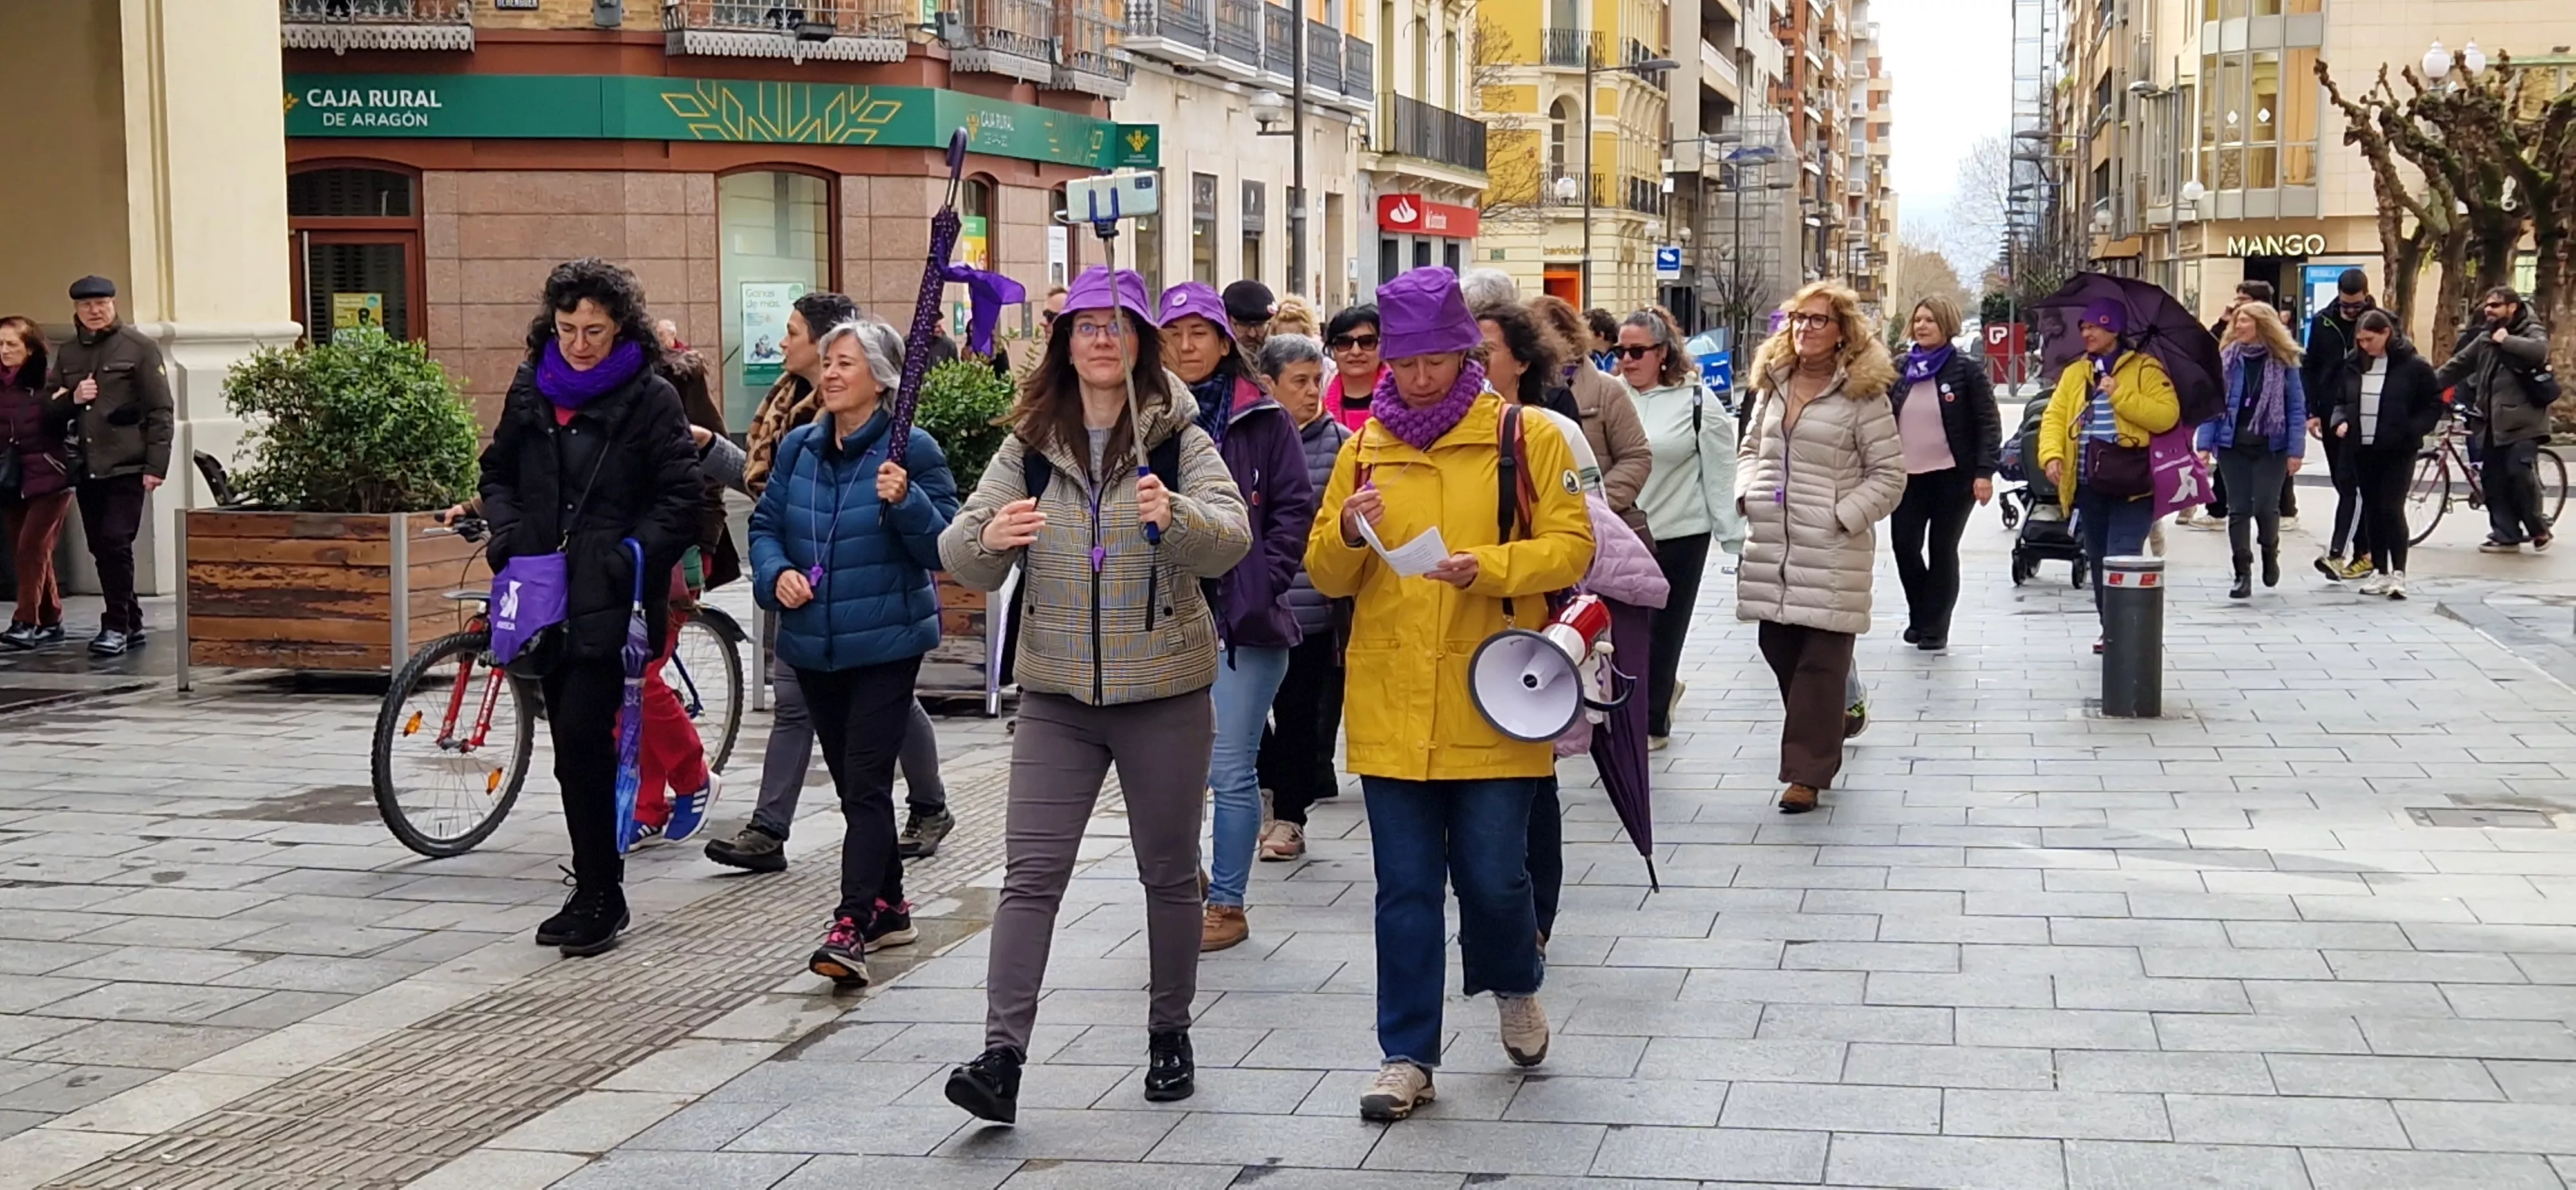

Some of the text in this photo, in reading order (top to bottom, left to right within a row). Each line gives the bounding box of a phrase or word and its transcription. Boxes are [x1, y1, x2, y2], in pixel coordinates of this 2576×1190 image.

[307, 88, 442, 108] CAJA RURAL
[323, 109, 428, 127] DE ARAGÓN
[2226, 234, 2325, 256] MANGO
